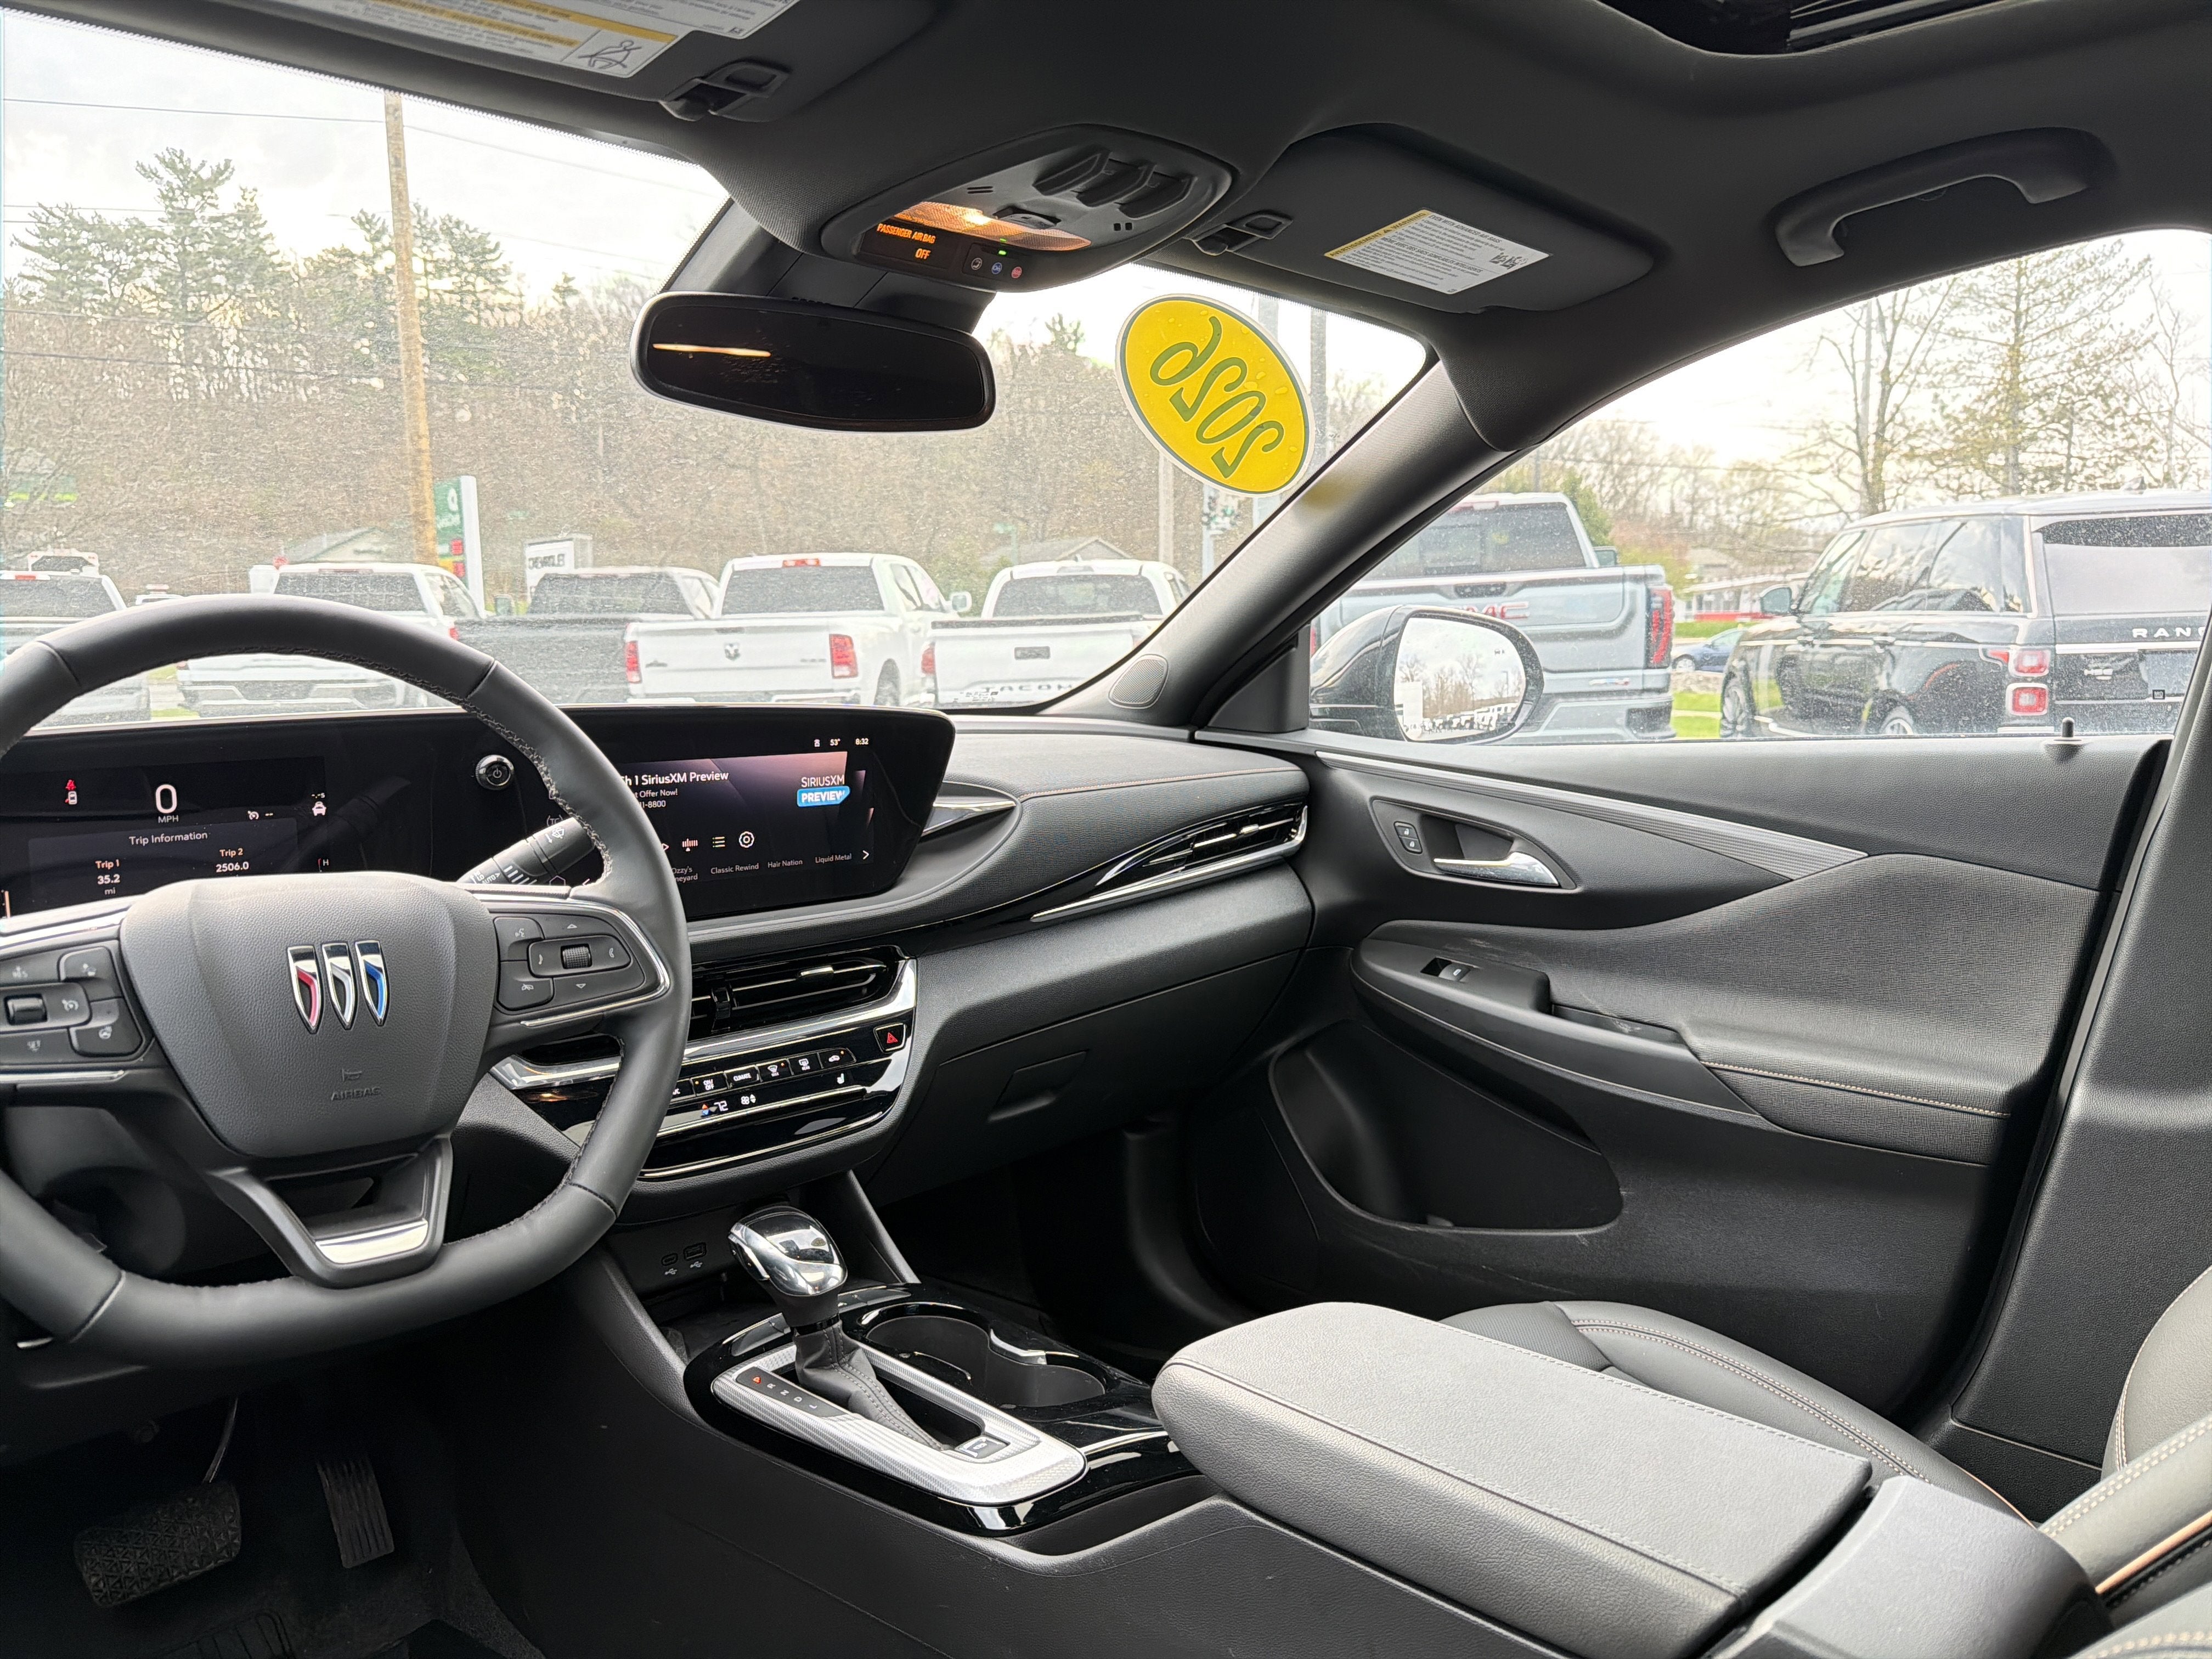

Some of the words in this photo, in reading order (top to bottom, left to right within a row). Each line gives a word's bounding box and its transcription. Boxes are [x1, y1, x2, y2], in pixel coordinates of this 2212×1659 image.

[1391, 212, 1426, 230] WARNING
[877, 223, 912, 238] PASSENGER
[912, 232, 923, 241] AIR
[922, 234, 936, 244] BAG
[1454, 223, 1481, 236] ADVANCED
[915, 248, 932, 259] OFF
[855, 737, 869, 746] 8:32
[634, 776, 639, 786] 1
[641, 772, 687, 786] SiriusXM
[689, 770, 729, 782] Preview
[801, 774, 845, 788] SIRIUSXM
[660, 788, 678, 797] Now!
[801, 790, 846, 803] PREVIEW
[155, 784, 177, 814] 0
[158, 814, 179, 823] MPH
[129, 836, 149, 847] Trip
[151, 832, 207, 844] Information
[219, 849, 236, 858] Trip
[238, 848, 244, 856] 2
[815, 855, 834, 864] Liquid
[834, 853, 852, 861] Metal
[95, 860, 114, 870] Trip
[115, 859, 120, 867] 1
[216, 861, 249, 873] 2506.0
[672, 866, 693, 875] Ozzy's
[710, 866, 734, 874] Classic
[735, 862, 759, 872] Rewind
[97, 873, 121, 885] 35.2
[675, 873, 698, 883] neyard
[104, 887, 116, 895] mi
[733, 1073, 752, 1081] CLIMATE
[331, 1086, 381, 1102] AIRBAG
[714, 1100, 729, 1112] 72
[753, 1376, 761, 1384] P
